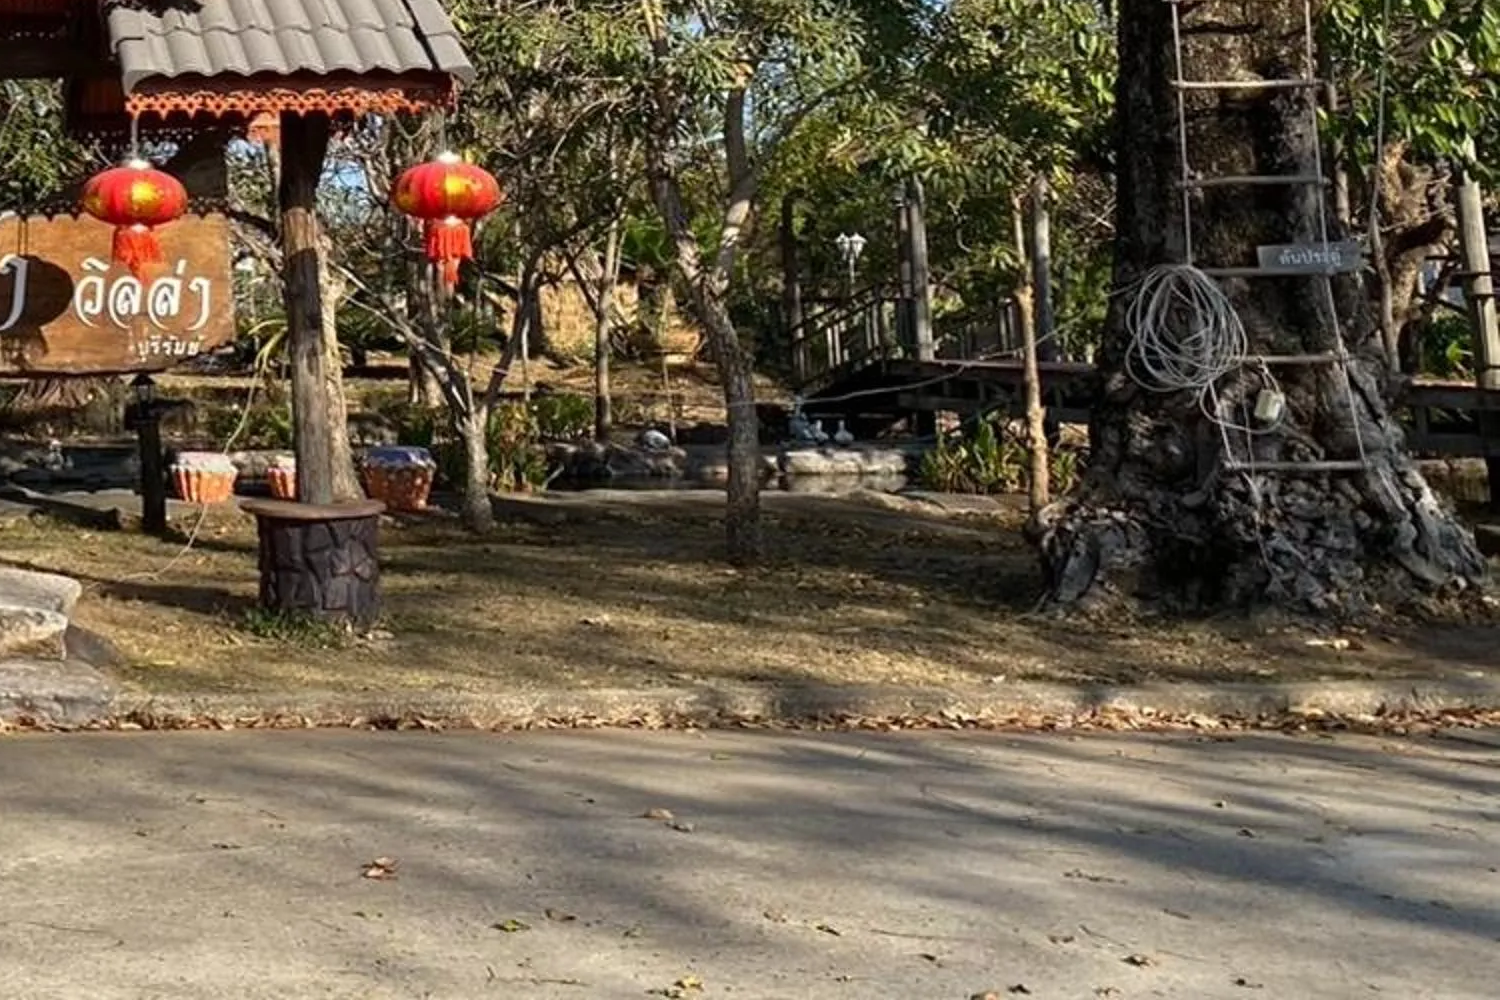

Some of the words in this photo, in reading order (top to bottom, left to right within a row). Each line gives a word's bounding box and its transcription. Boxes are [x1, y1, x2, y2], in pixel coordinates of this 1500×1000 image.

[74, 256, 212, 331] วิลล่า
[136, 334, 206, 363] บุรีรัมย์
